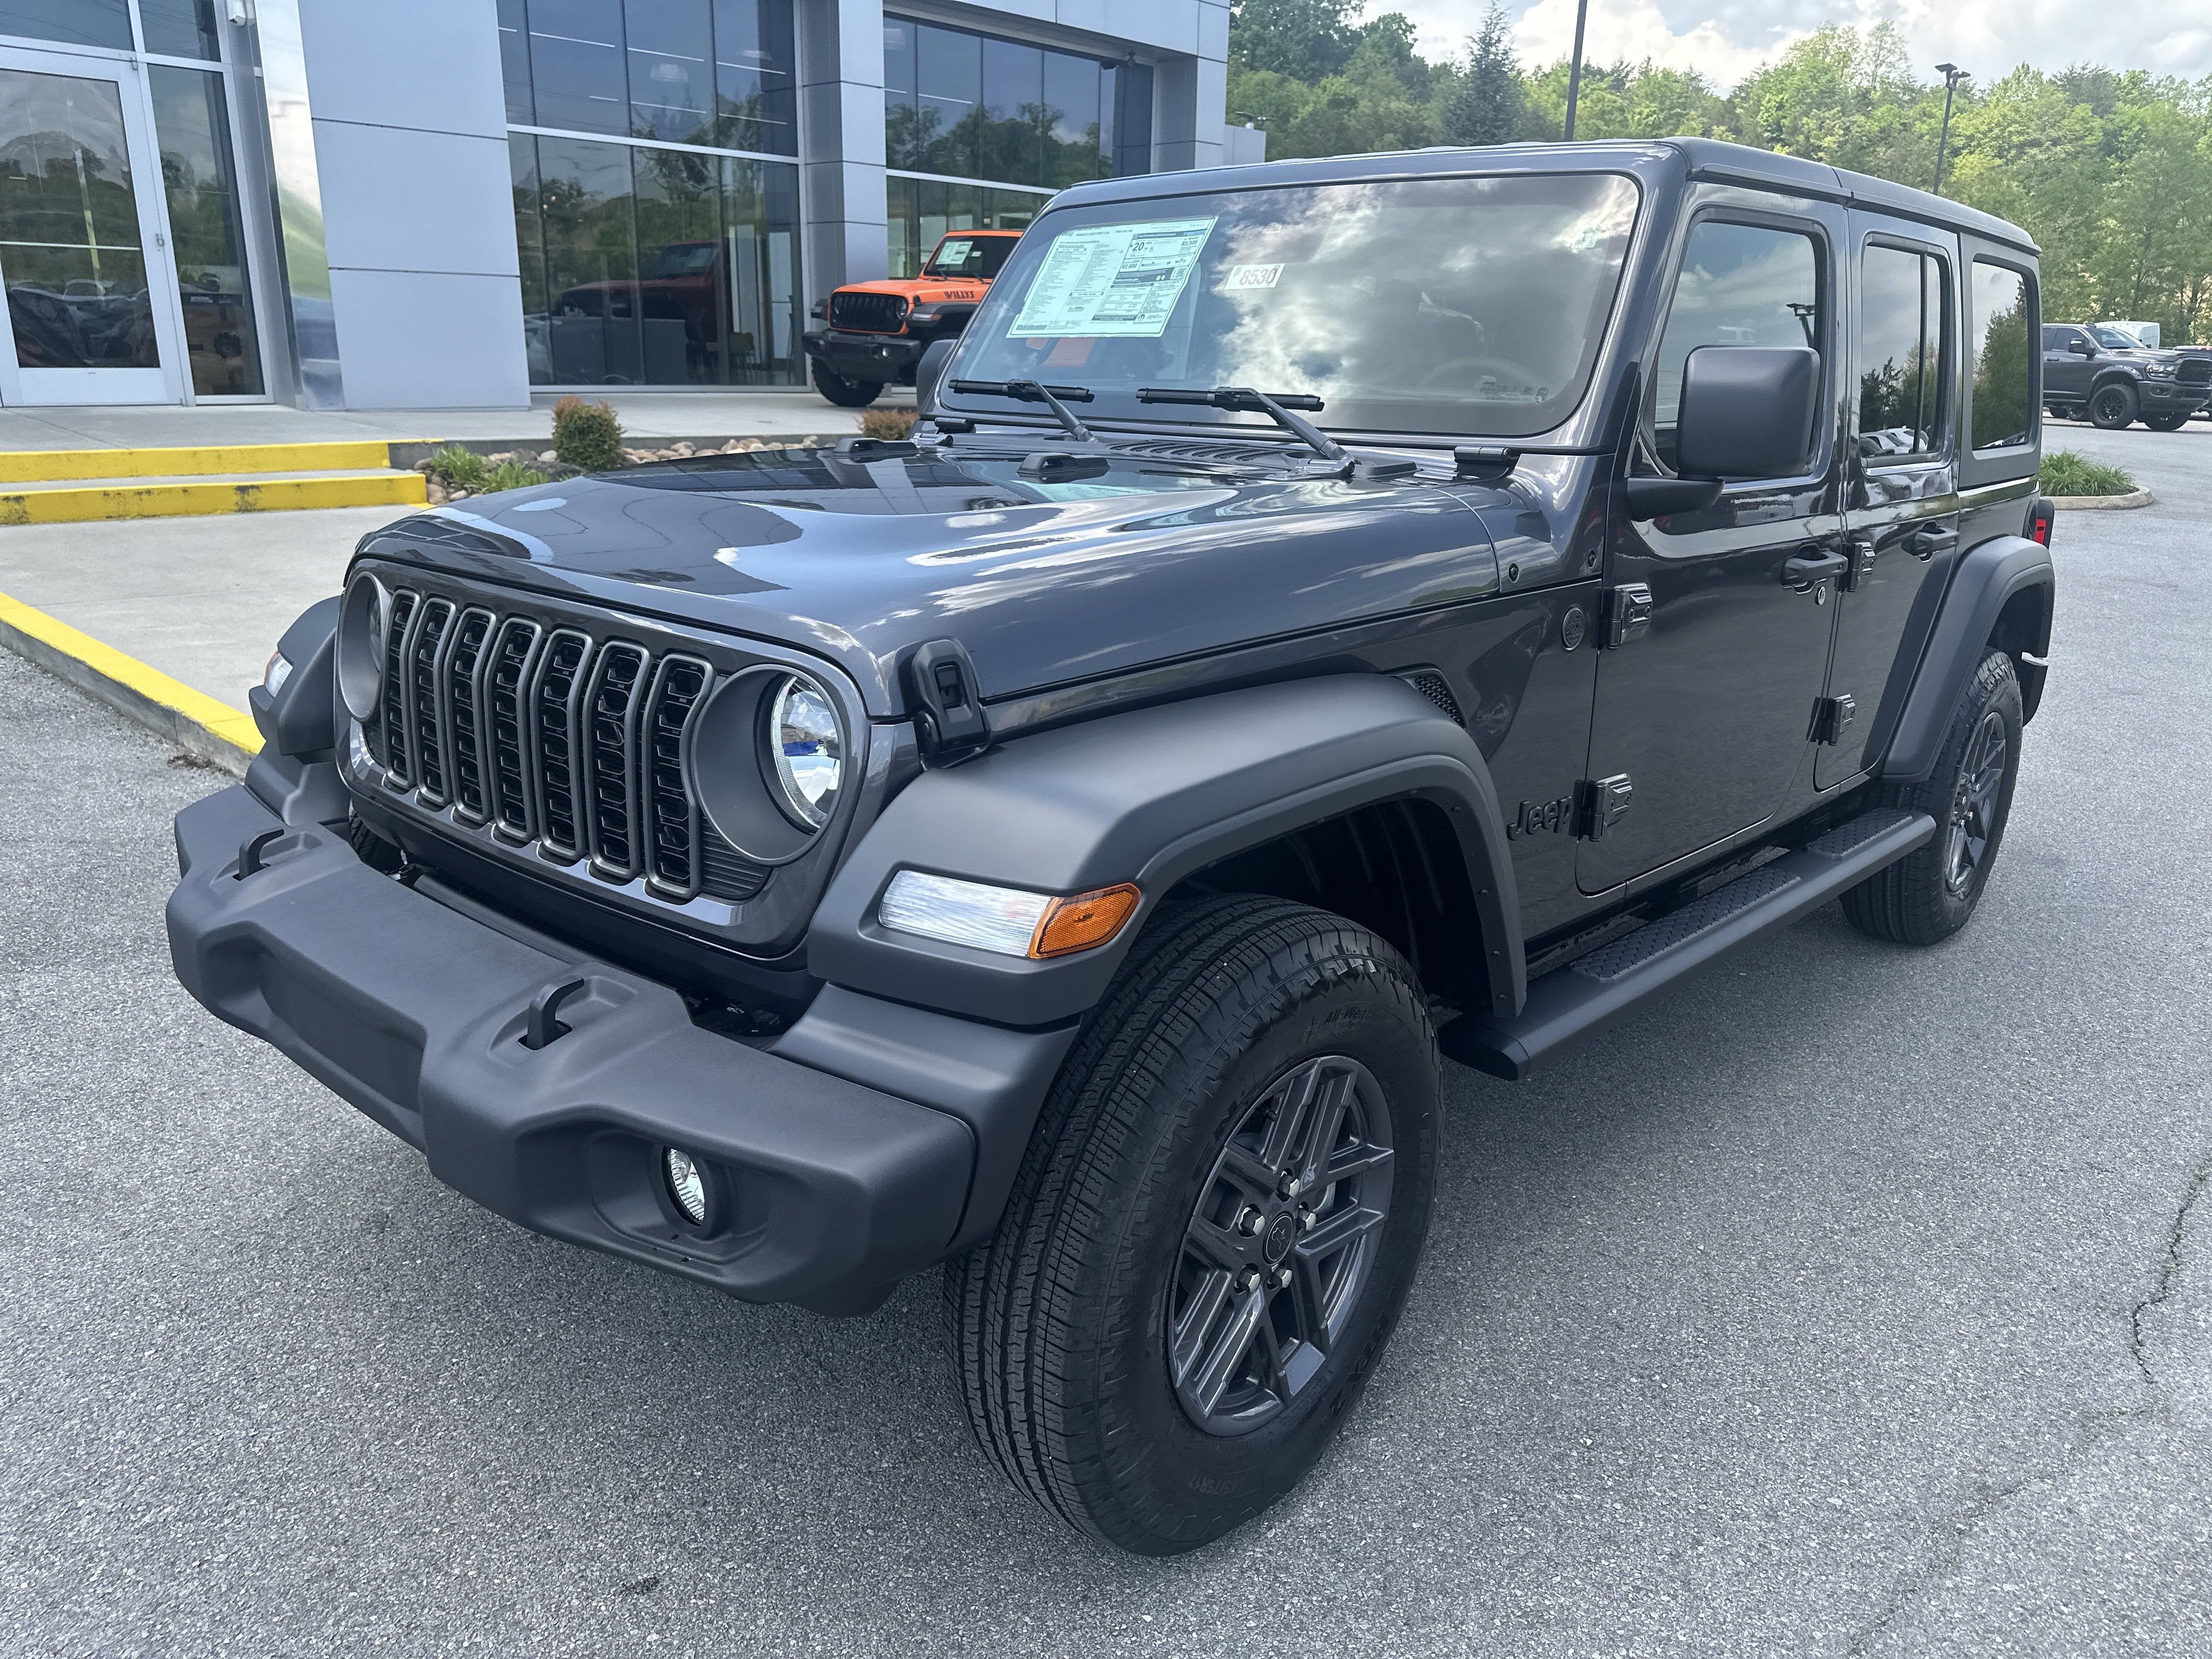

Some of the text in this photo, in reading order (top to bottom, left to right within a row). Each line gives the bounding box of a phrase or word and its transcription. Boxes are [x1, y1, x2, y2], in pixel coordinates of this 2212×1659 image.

[1132, 242, 1144, 251] 20
[1239, 268, 1278, 285] 8530
[943, 291, 975, 299] WILLYS
[1506, 796, 1573, 840] Jeep
